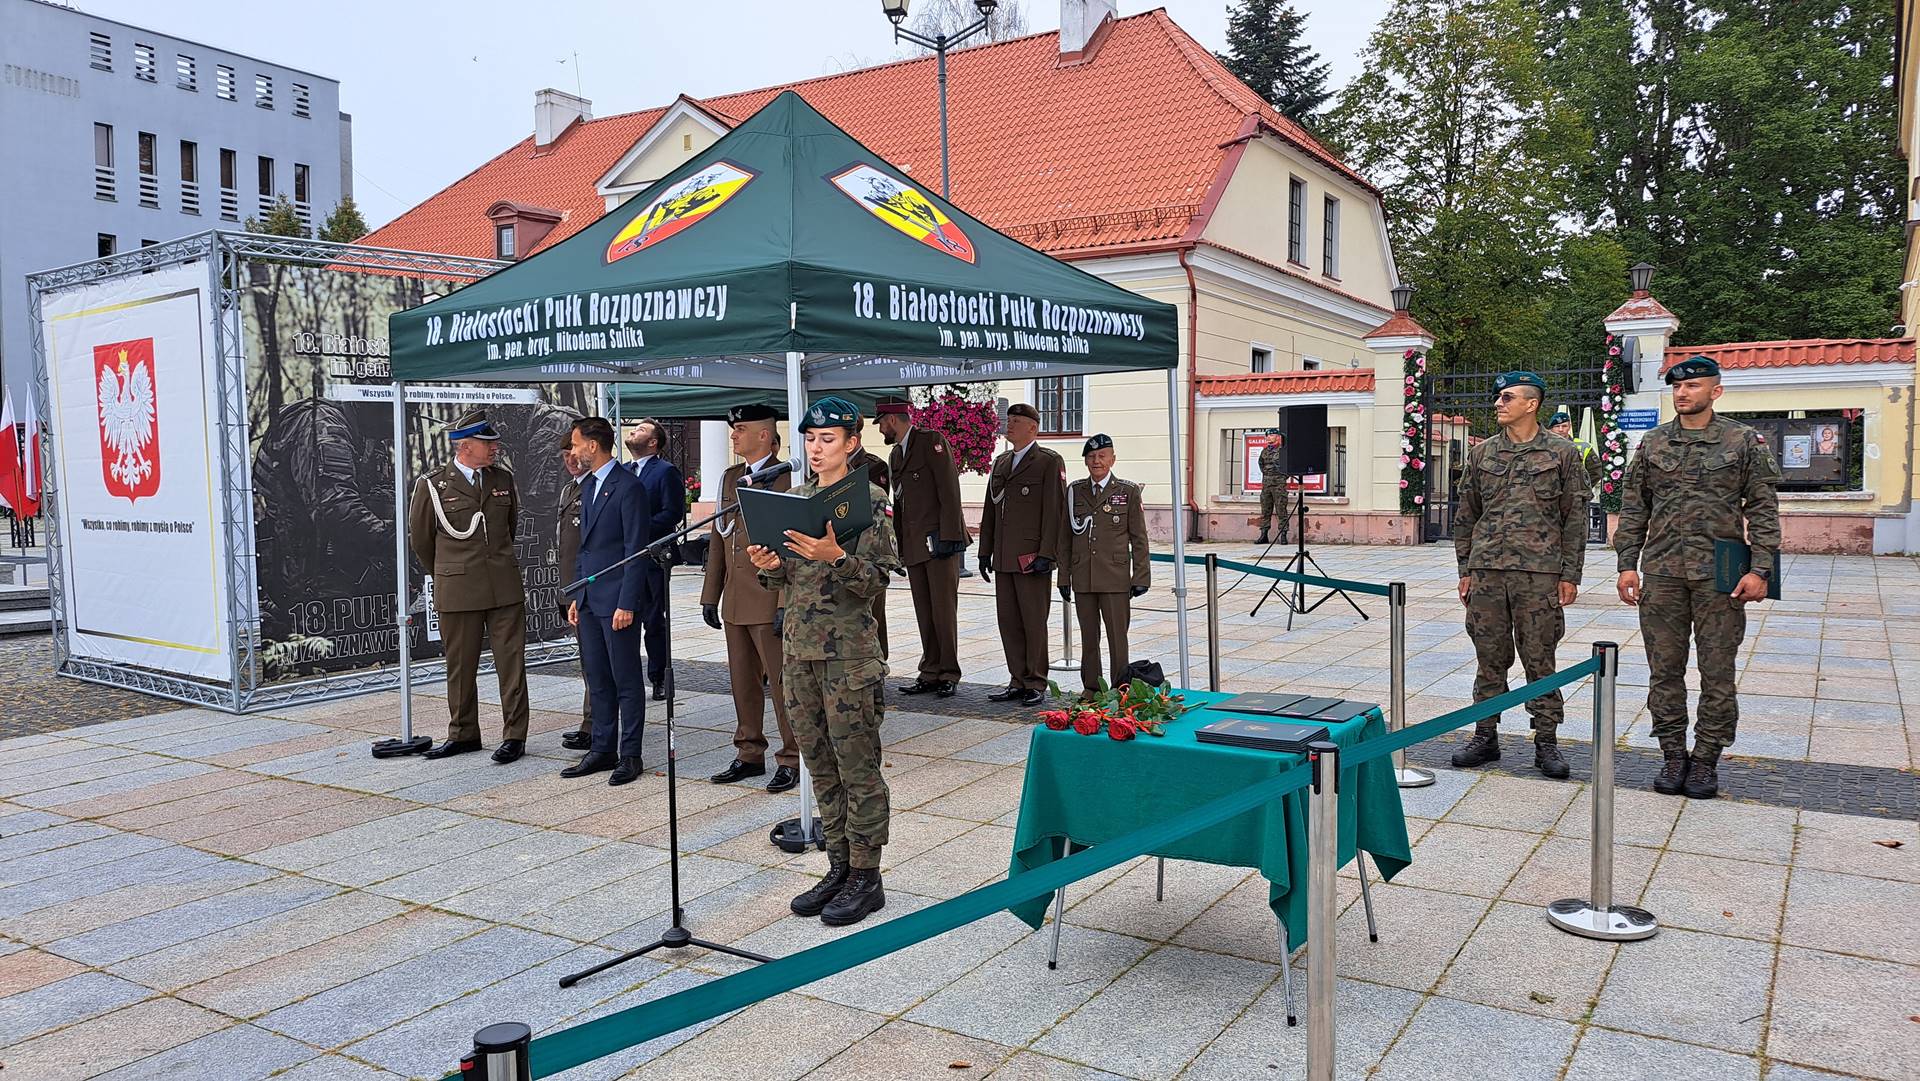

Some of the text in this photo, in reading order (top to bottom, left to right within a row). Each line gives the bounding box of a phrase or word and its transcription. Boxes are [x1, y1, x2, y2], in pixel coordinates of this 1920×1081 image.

[426, 285, 728, 346] 18. Białostocki Pułk Rozpoznawczy
[853, 281, 1145, 341] 18. Białostocki Pułk Rozpoznawczy
[293, 332, 320, 354] 18.
[487, 326, 645, 361] im. gen. bryg. Nikodema Sulika
[938, 326, 1090, 354] im. gen. bryg. Nikodema Sulika
[330, 358, 355, 377] im.
[289, 600, 326, 637] 18
